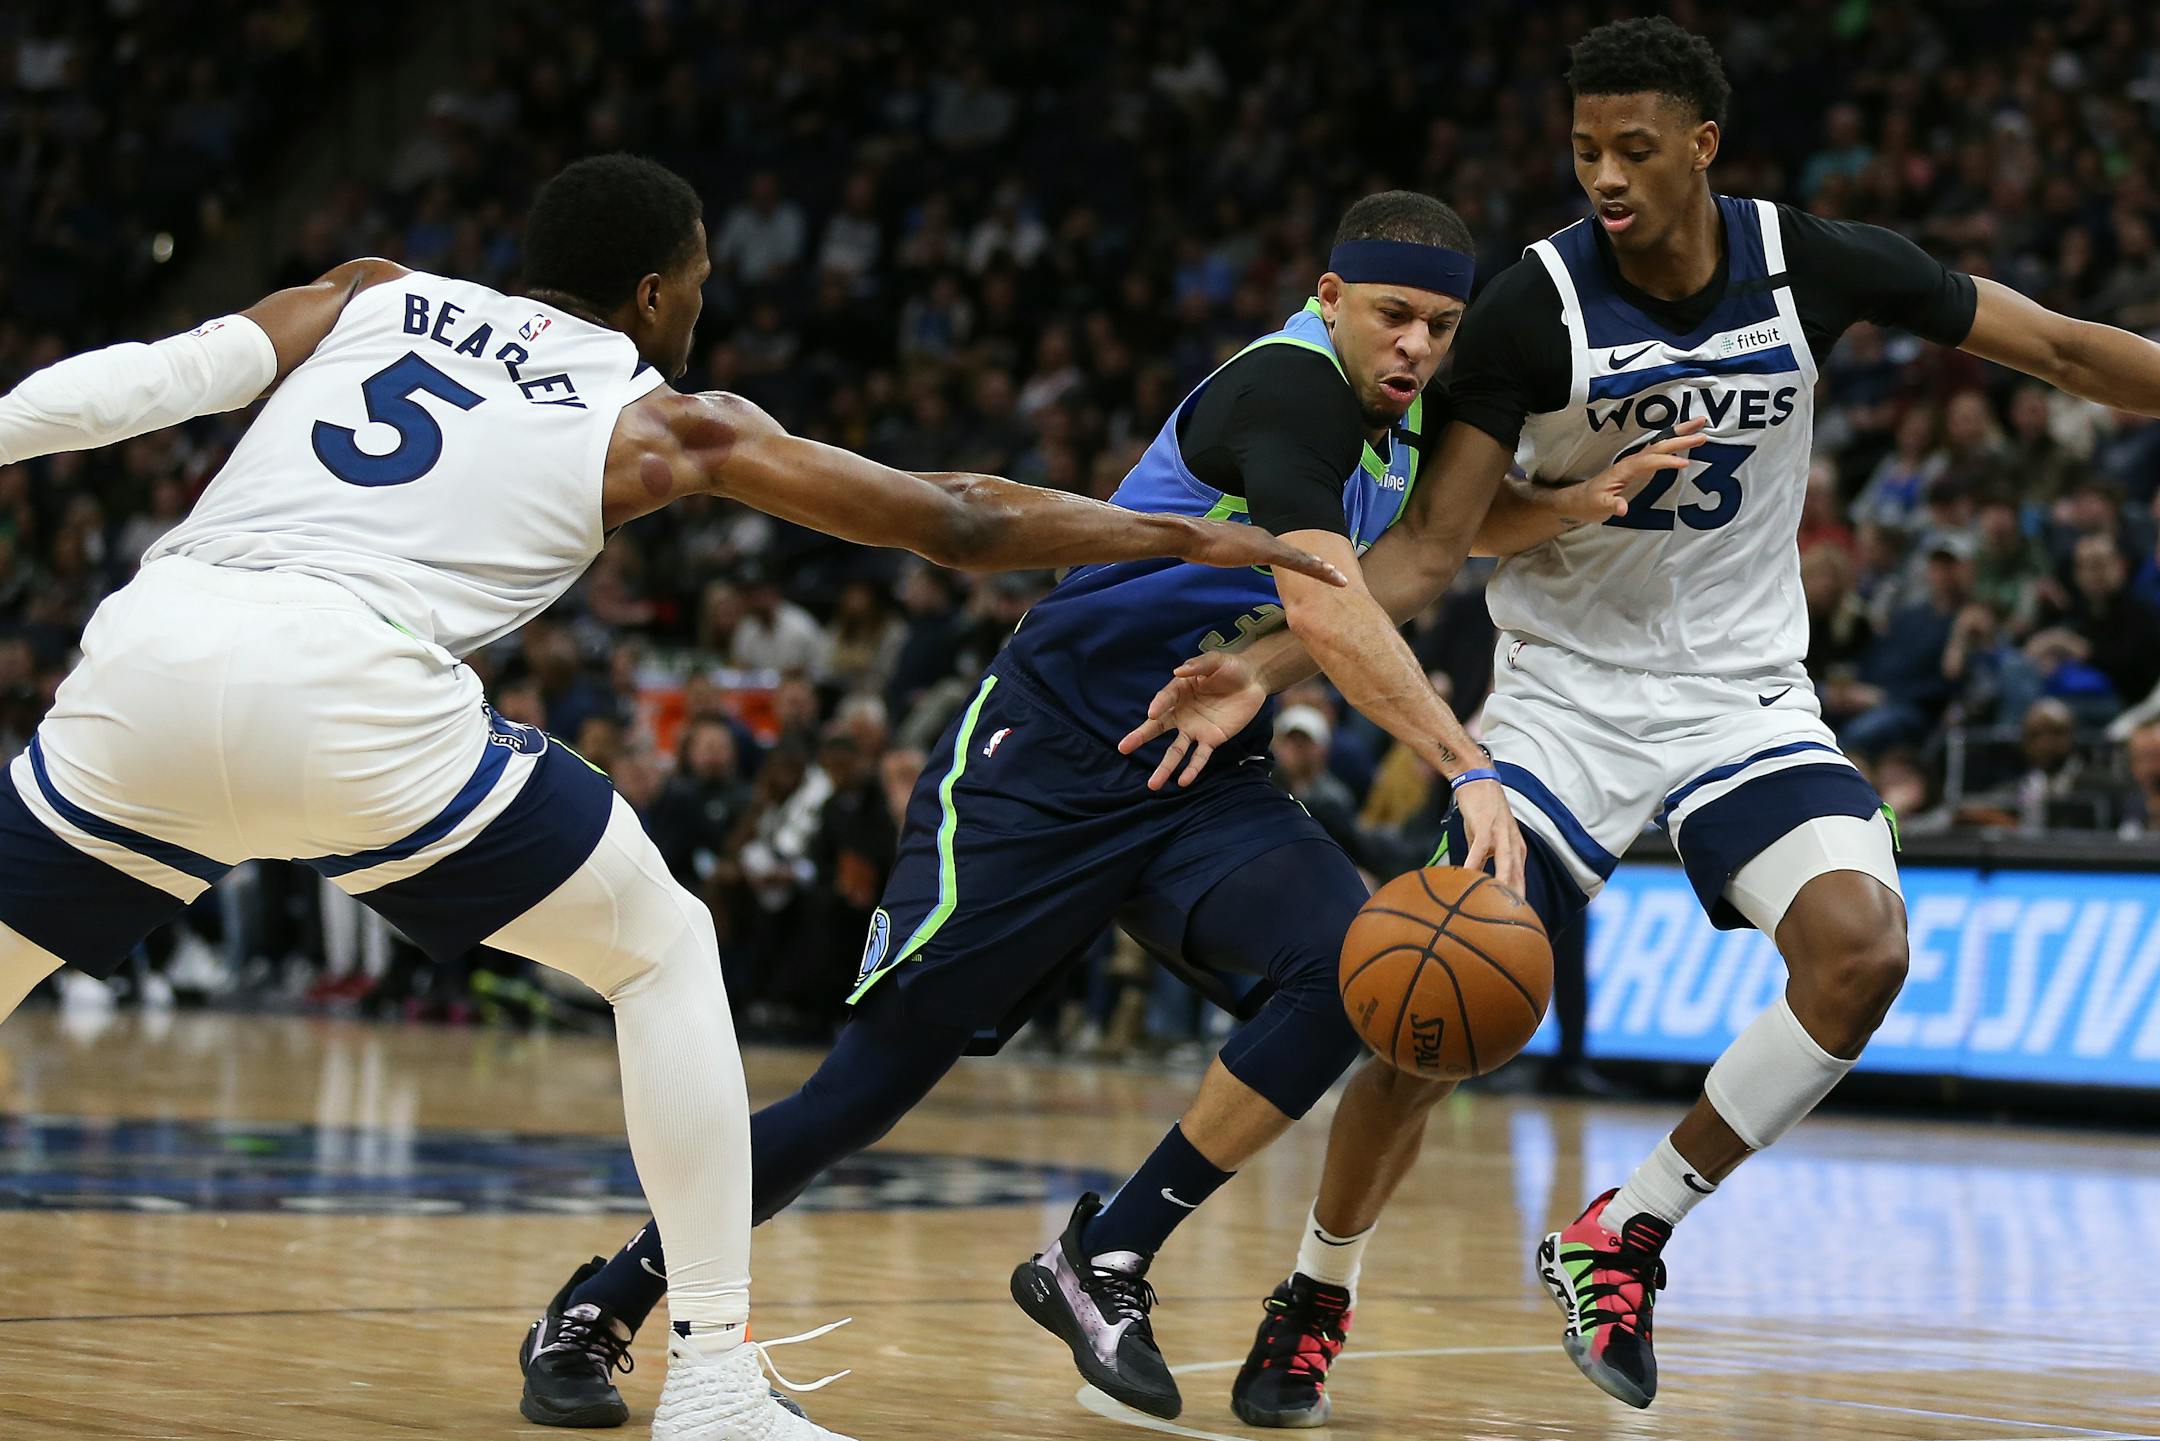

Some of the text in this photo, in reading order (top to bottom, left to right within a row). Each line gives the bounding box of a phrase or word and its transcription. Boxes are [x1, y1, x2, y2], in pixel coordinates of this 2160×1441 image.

[1737, 328, 1780, 349] fitbit
[312, 351, 486, 487] 5
[1587, 387, 1798, 432] WOLVES
[1602, 442, 1756, 530] 23
